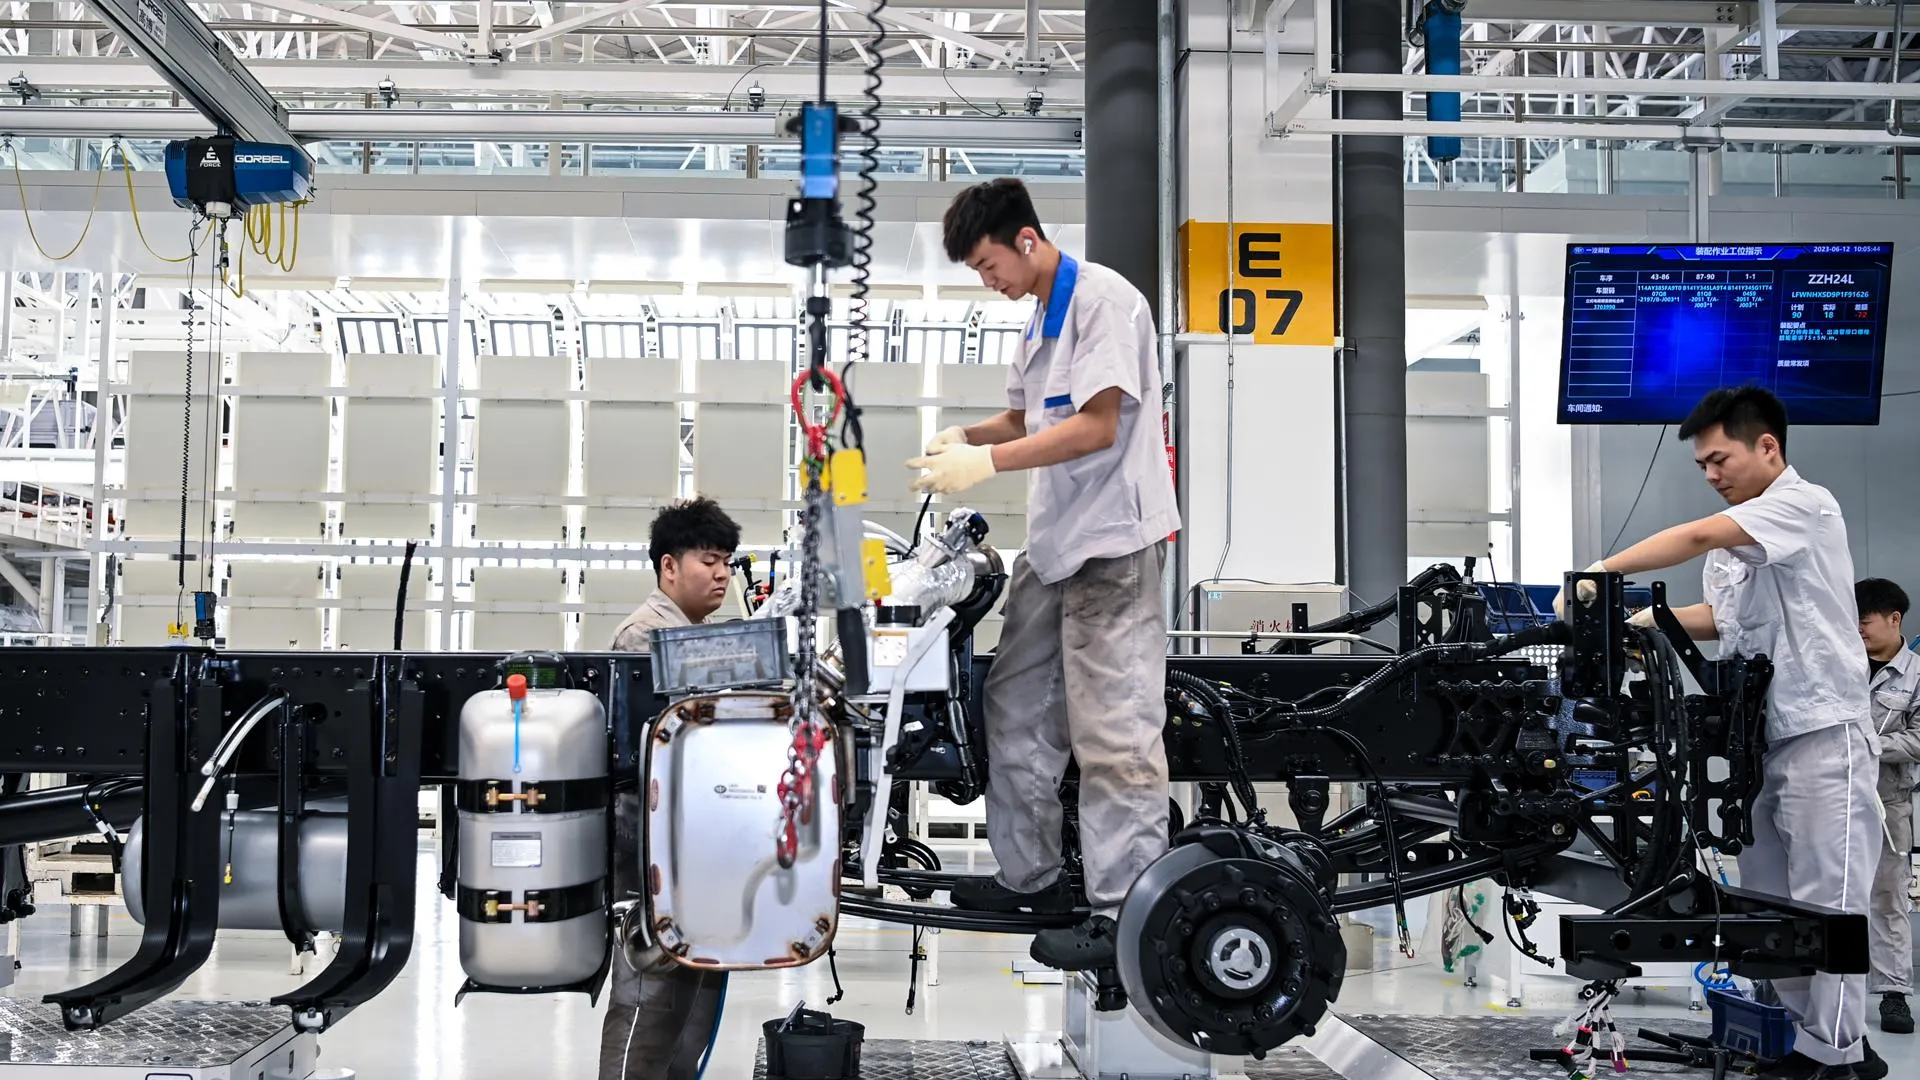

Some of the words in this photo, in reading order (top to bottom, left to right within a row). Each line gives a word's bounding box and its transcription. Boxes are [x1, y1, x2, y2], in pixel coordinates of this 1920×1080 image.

[234, 154, 289, 164] GORBEL
[1239, 233, 1282, 277] E
[1695, 247, 1763, 256] 装配作业工位指示
[1599, 274, 1613, 282] 车序
[1808, 274, 1855, 285] ZZH24L
[1595, 286, 1616, 294] 车型码
[1219, 288, 1303, 335] 07
[1567, 404, 1602, 413] 车间通知:
